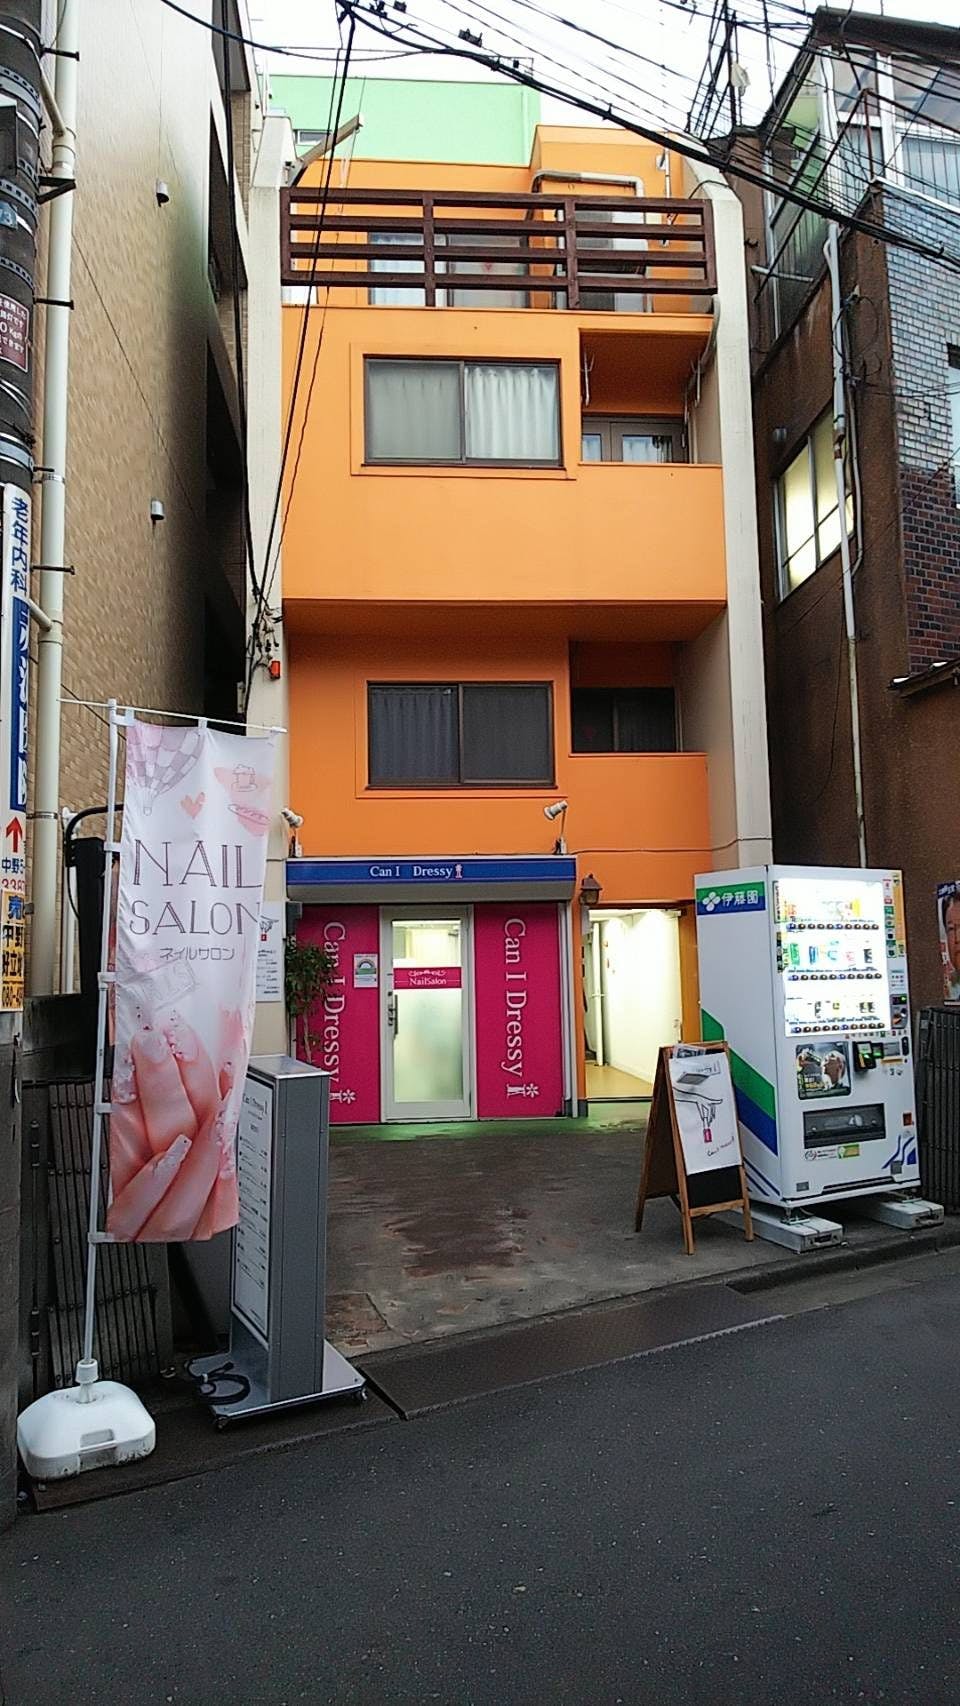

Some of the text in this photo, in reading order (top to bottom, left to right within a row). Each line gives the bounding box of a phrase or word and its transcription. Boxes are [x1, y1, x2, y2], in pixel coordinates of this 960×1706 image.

[11, 497, 28, 598] 老年内科
[133, 838, 262, 888] NAIL
[370, 866, 453, 879] Can I Dressy
[129, 900, 260, 935] SALON
[159, 946, 235, 961] ネイルサロン
[501, 918, 528, 1077] Can I Dressy
